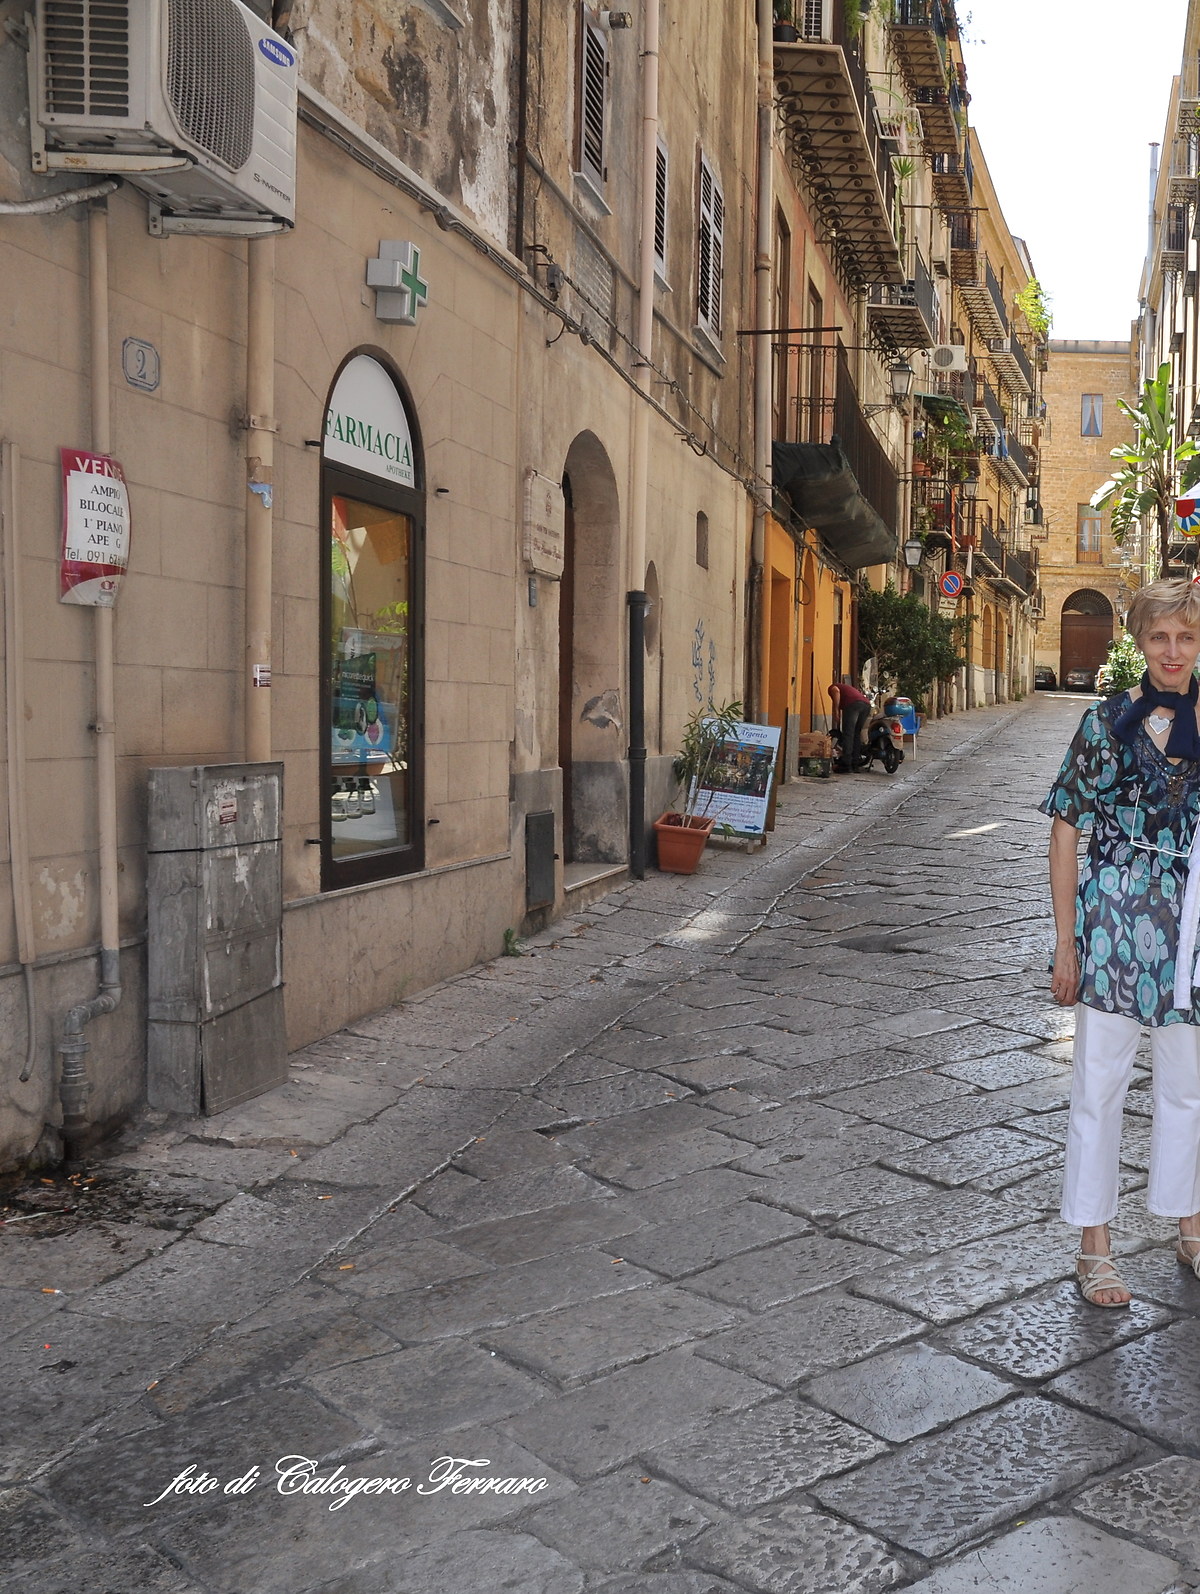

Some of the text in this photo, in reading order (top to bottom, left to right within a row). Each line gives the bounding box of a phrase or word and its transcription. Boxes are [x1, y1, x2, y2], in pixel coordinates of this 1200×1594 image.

[262, 39, 291, 67] SAMSUNG
[325, 408, 412, 467] FARMACIA
[386, 464, 411, 480] APOTHEKE
[91, 484, 120, 500] AMPIO
[79, 498, 124, 518] BILOCALE
[97, 520, 122, 535] PIANO
[88, 534, 109, 546] APE
[65, 547, 82, 560] Tel.
[87, 550, 105, 562] 091
[739, 729, 768, 739] Argento
